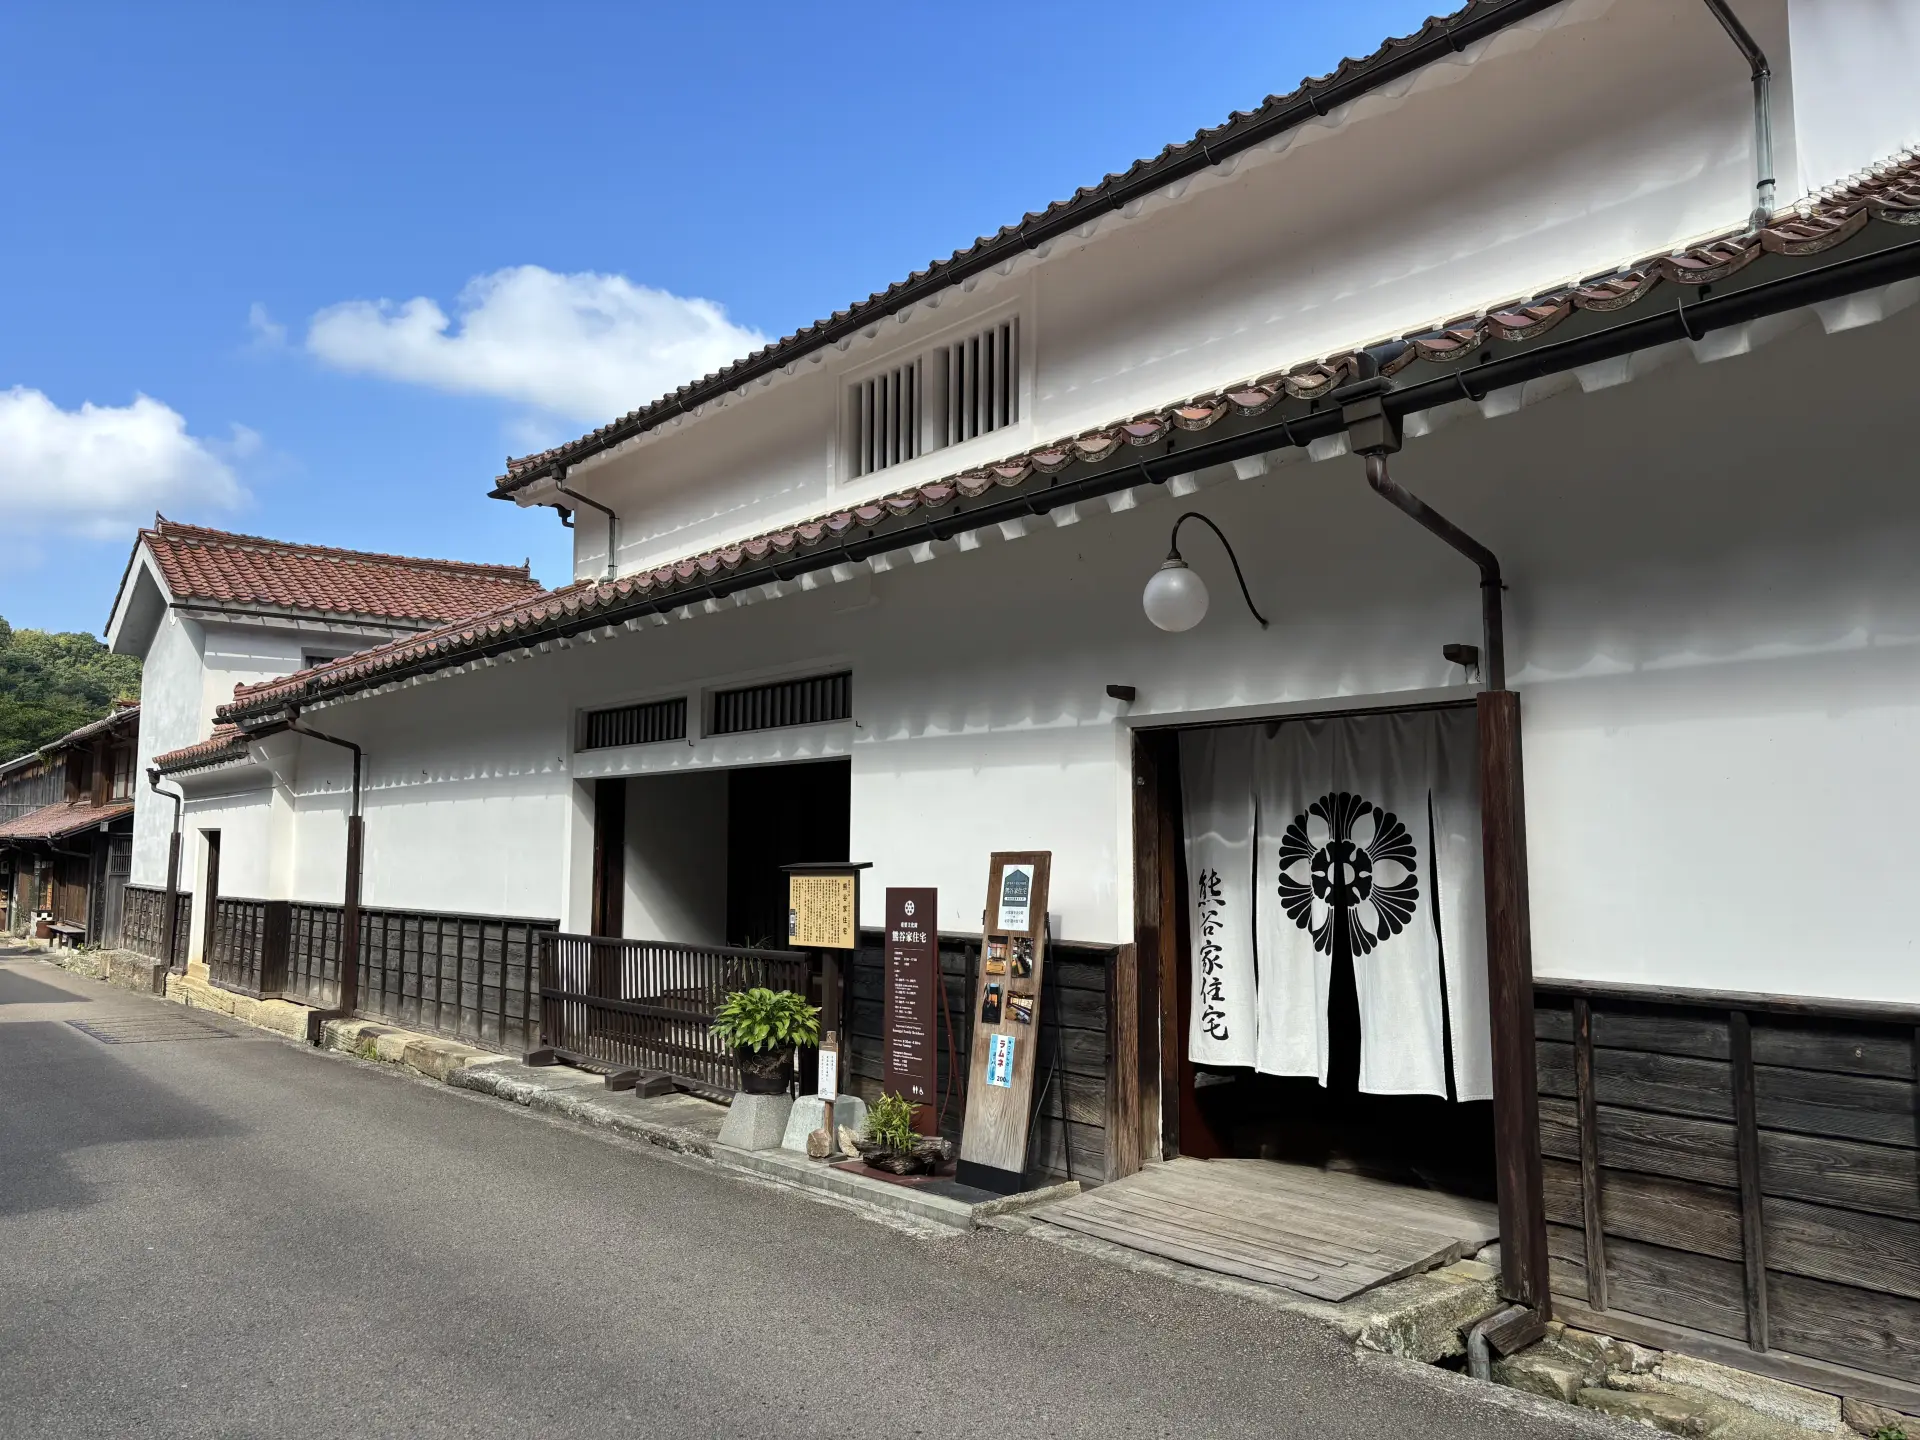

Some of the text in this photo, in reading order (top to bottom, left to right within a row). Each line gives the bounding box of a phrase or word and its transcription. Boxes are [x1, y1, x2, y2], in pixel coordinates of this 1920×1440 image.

[892, 930, 927, 943] 熊谷家住宅
[1198, 868, 1229, 1041] 熊谷家住宅
[997, 1039, 1006, 1067] ラムネ
